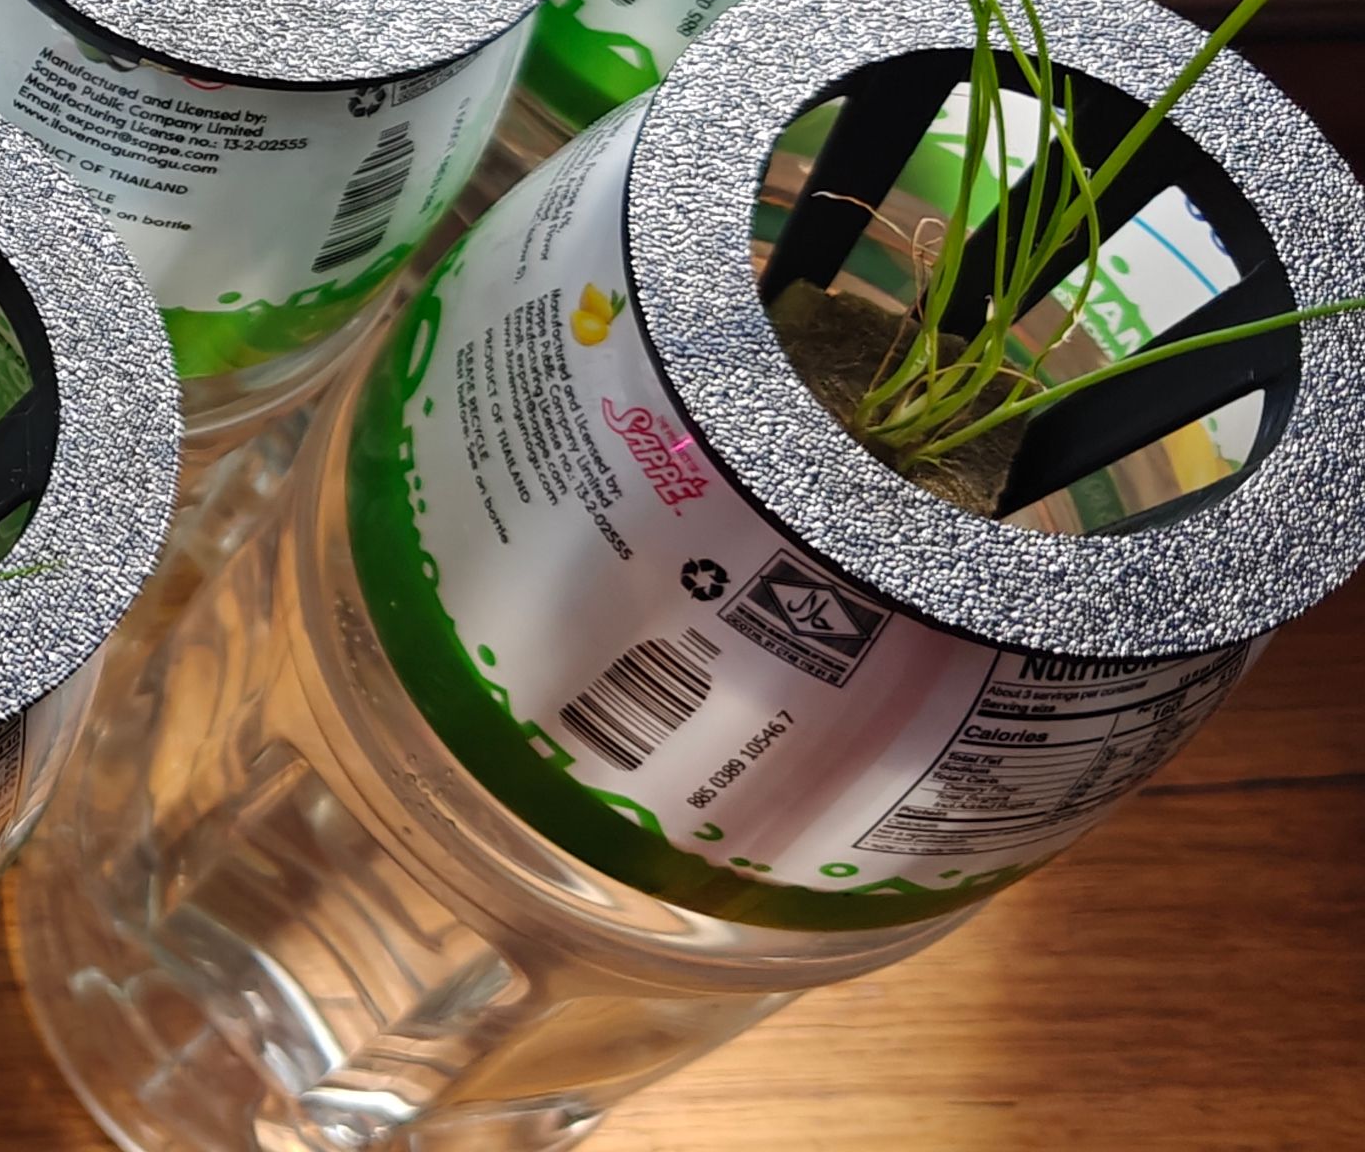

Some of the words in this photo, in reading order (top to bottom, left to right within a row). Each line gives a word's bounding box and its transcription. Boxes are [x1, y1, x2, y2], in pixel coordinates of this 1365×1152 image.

[24, 73, 126, 129] Manufacturing
[130, 120, 185, 143] License
[223, 137, 309, 151] 13-2-02555
[31, 60, 78, 91] Sappe
[81, 85, 124, 111] Public
[129, 104, 202, 134] Company
[207, 121, 265, 137] Limited
[39, 47, 139, 100] Manufactured
[142, 94, 172, 110] and
[176, 101, 241, 121] Licensed
[245, 111, 267, 124] by:
[12, 99, 218, 175] www.ilovemogumogu.com
[18, 86, 62, 116] Email:
[65, 113, 220, 162] export@sappe.com
[79, 159, 103, 174] OF
[109, 169, 189, 195] THAILAND
[117, 209, 138, 222] on
[142, 215, 191, 231] bottle
[543, 340, 560, 382] Public
[550, 287, 575, 384] Manufactured
[563, 382, 580, 414] and
[575, 412, 610, 477] Licensed
[490, 403, 504, 426] OF
[515, 347, 568, 496] export@sappe.com
[526, 300, 544, 397] Manufacturing
[538, 396, 565, 451] License
[573, 480, 634, 561] 13-2-02555
[548, 383, 580, 454] Company
[495, 426, 531, 504] THAILAND
[576, 450, 612, 509] Limited
[986, 685, 1019, 699] About
[686, 782, 718, 810] 885
[709, 758, 747, 789] 0389
[740, 718, 787, 760] 10546
[780, 709, 795, 725] 7
[962, 725, 1049, 744] Calories
